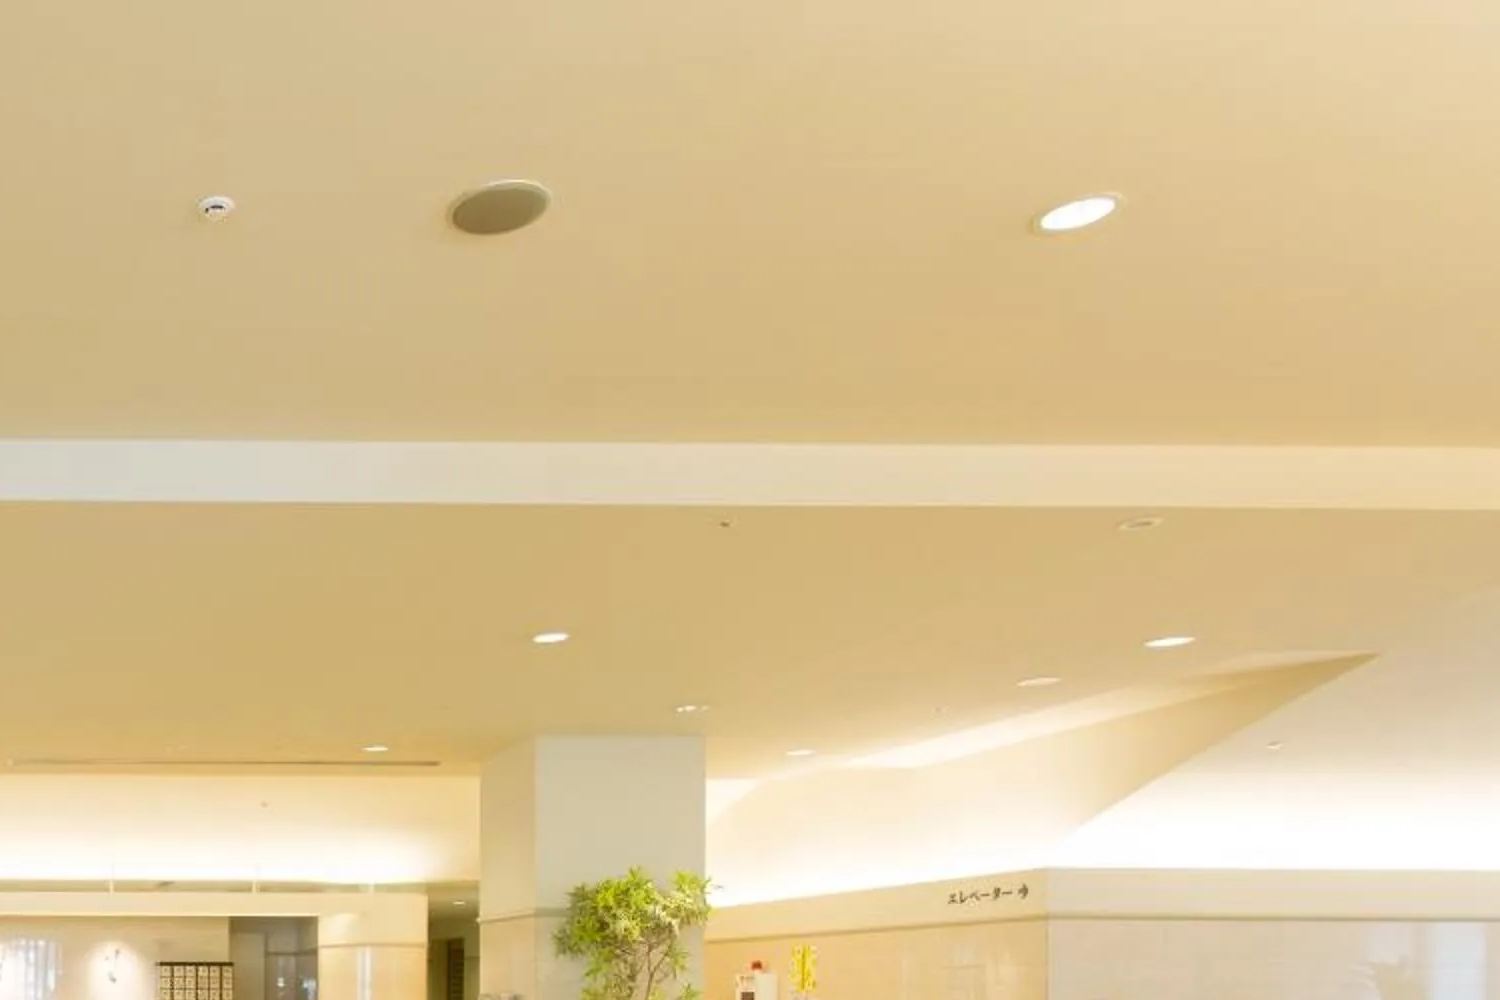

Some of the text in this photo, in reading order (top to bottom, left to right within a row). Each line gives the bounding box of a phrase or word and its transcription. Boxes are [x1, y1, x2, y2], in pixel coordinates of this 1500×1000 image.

[947, 887, 1013, 905] エレベーター
